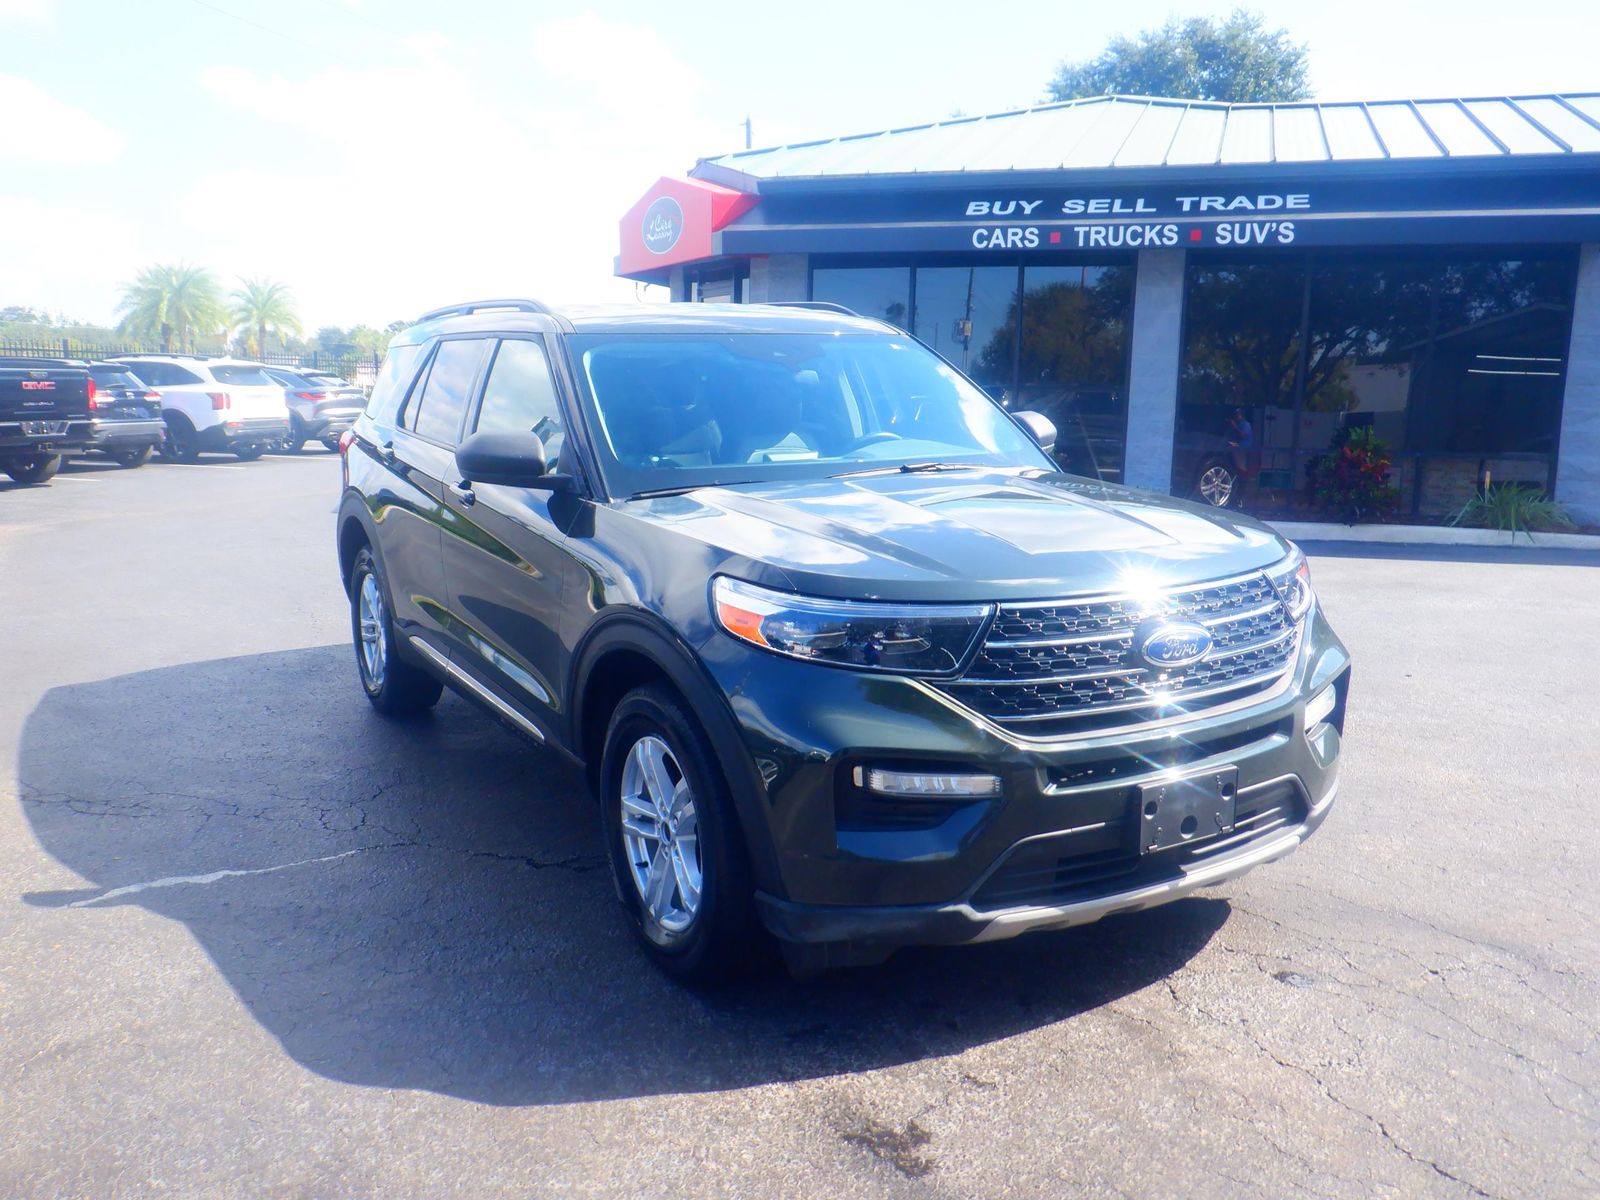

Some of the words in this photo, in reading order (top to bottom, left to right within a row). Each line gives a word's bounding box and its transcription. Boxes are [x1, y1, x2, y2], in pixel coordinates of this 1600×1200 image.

[965, 200, 1043, 216] BUY
[1061, 198, 1157, 214] SELL
[1175, 194, 1311, 212] TRADE
[971, 228, 1039, 248] CARS
[1074, 225, 1179, 247] TRUCKS
[1215, 222, 1295, 245] SUV'S
[1162, 637, 1199, 659] Ford
